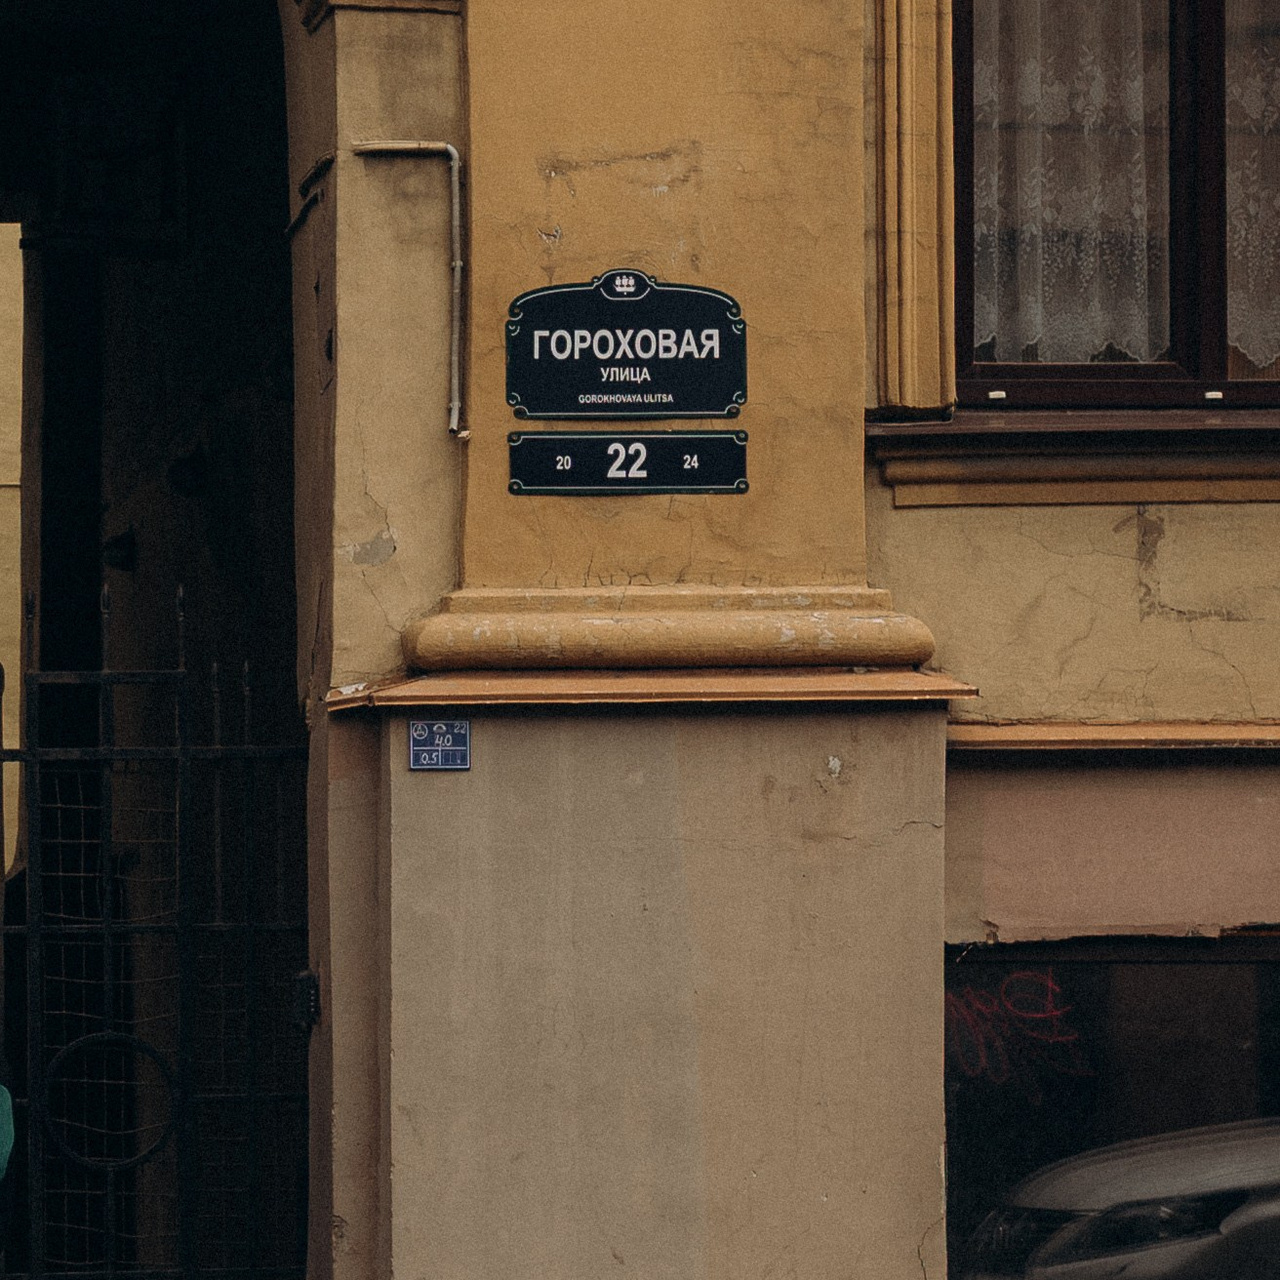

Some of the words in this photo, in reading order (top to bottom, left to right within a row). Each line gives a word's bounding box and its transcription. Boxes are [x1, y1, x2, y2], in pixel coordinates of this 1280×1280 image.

[533, 328, 720, 360] ГОРОХОВАЯ
[600, 366, 652, 385] УЛИЦА
[578, 393, 642, 404] GOROKHOVAYA
[643, 393, 674, 404] ULITSA
[555, 455, 572, 470] 20
[606, 442, 648, 479] 22
[683, 454, 700, 469] 24
